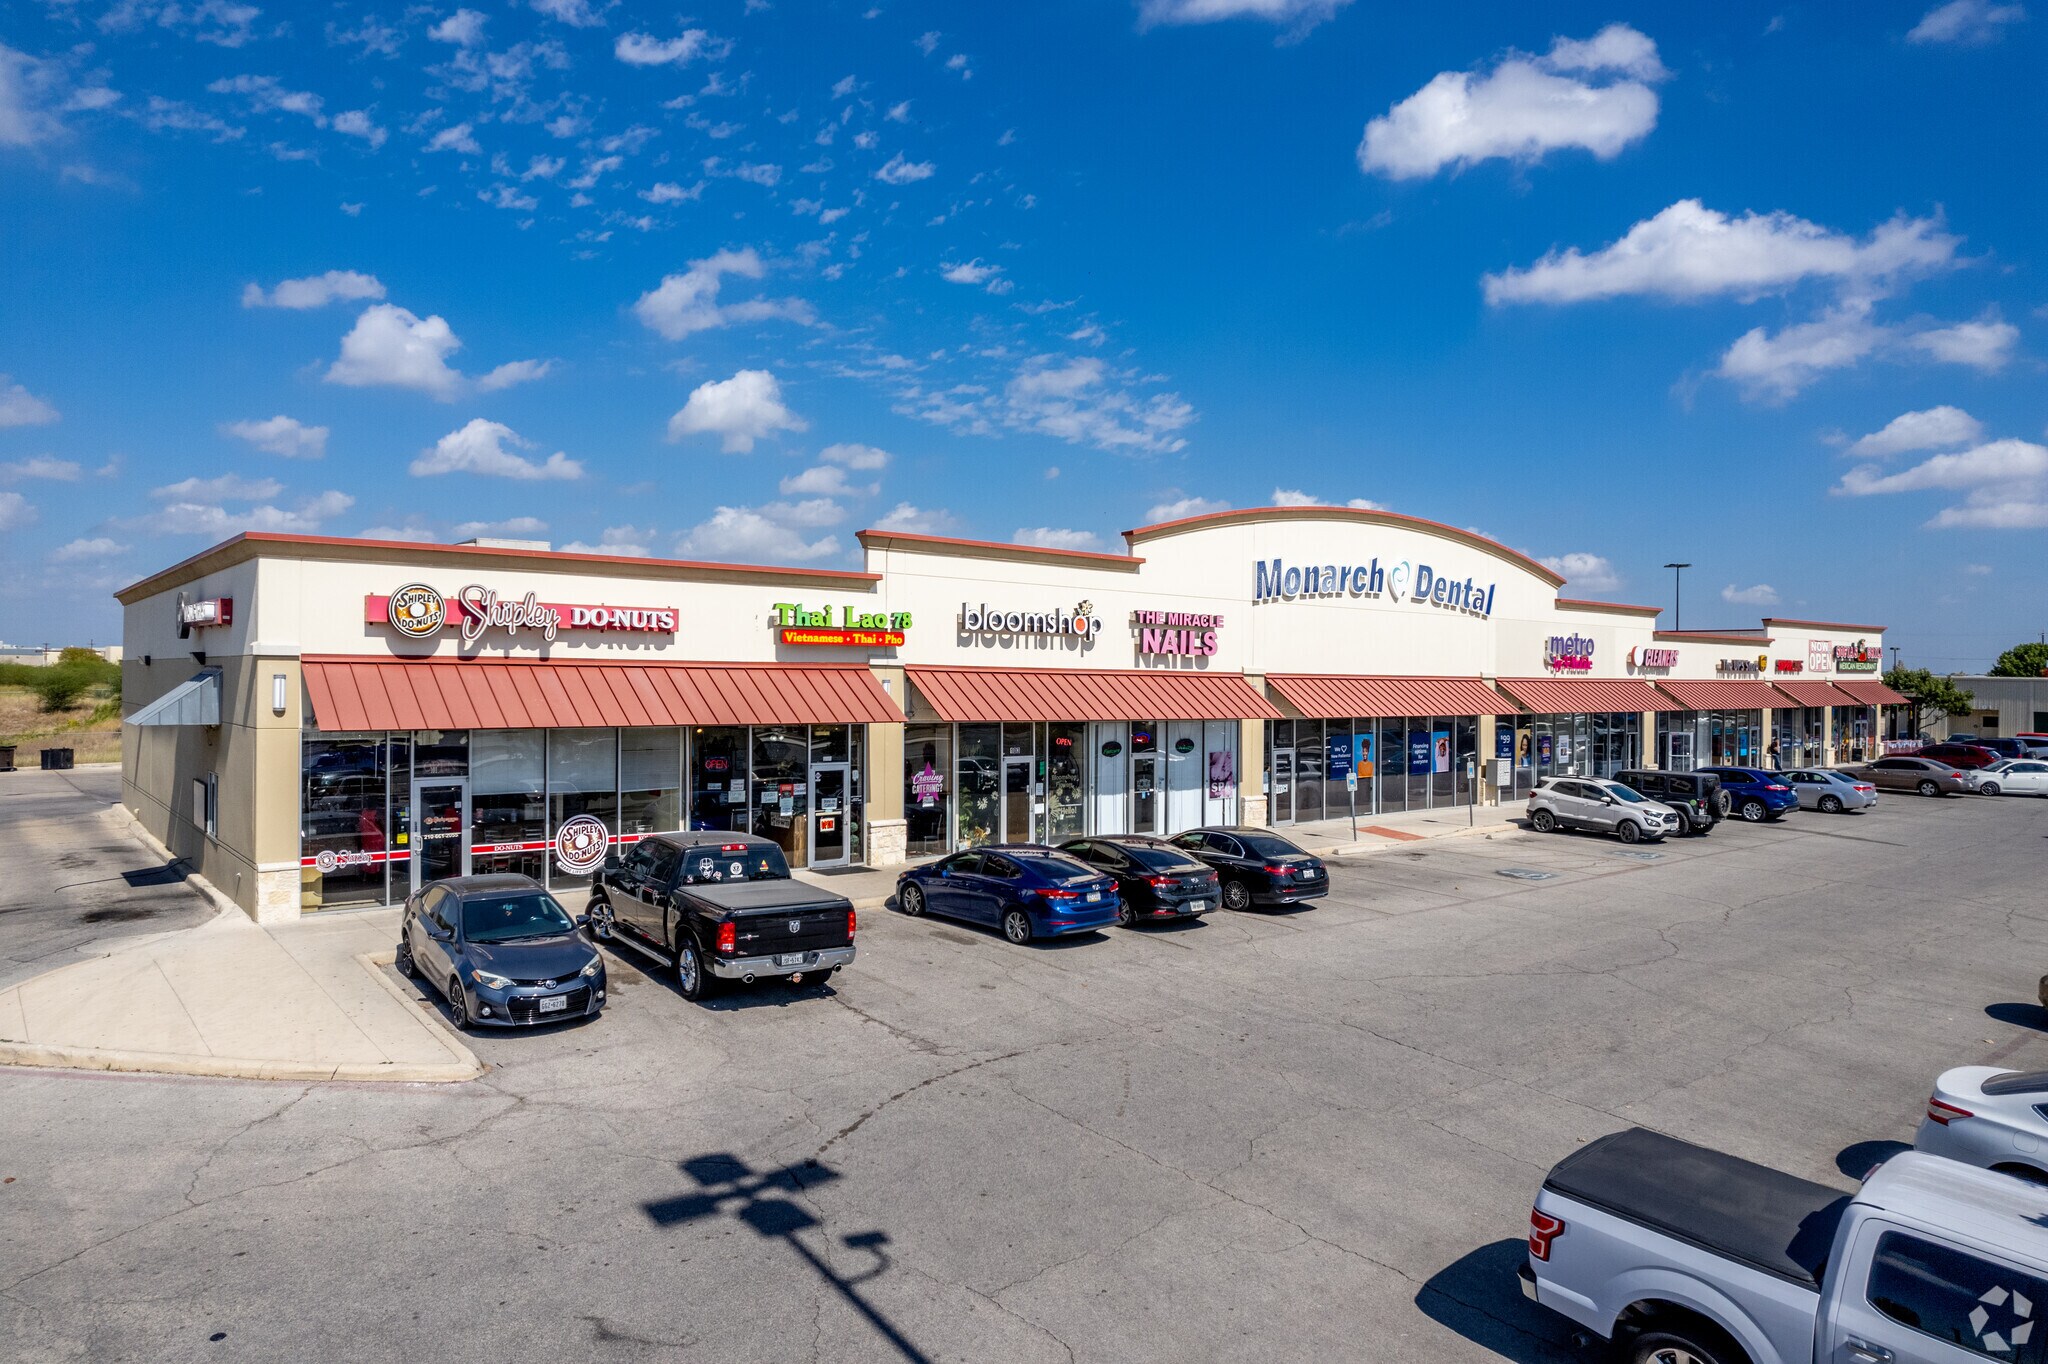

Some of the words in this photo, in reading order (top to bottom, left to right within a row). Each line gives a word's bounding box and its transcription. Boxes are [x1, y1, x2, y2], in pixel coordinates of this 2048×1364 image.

[1255, 556, 1385, 600] Monarch
[1414, 562, 1496, 616] Dental
[396, 592, 438, 608] SHIPLEY
[458, 583, 561, 642] Shipley
[571, 607, 676, 630] DO-NUTS
[772, 602, 833, 628] Thai
[843, 605, 888, 629] Lao
[890, 611, 913, 630] 78
[961, 601, 1104, 641] bloomshop
[1134, 609, 1164, 625] THE
[1165, 611, 1224, 629] MIRACLE
[785, 631, 844, 644] Vietnamese
[852, 633, 877, 645] Thai
[885, 634, 903, 645] Pho
[1139, 627, 1218, 657] NAILS
[1549, 632, 1595, 657] metro
[1811, 641, 1829, 652] NOW
[1643, 648, 1680, 667] CLEANERS
[1809, 652, 1833, 671] OPEN
[1055, 737, 1073, 746] OPEN
[704, 758, 729, 770] OPEN
[913, 769, 945, 785] Craving
[911, 783, 944, 795] CATERING?
[1211, 782, 1233, 794] SPA
[563, 825, 601, 842] SHIPLEY
[494, 843, 524, 852] DO-NUTS
[338, 849, 374, 869] Shipley
